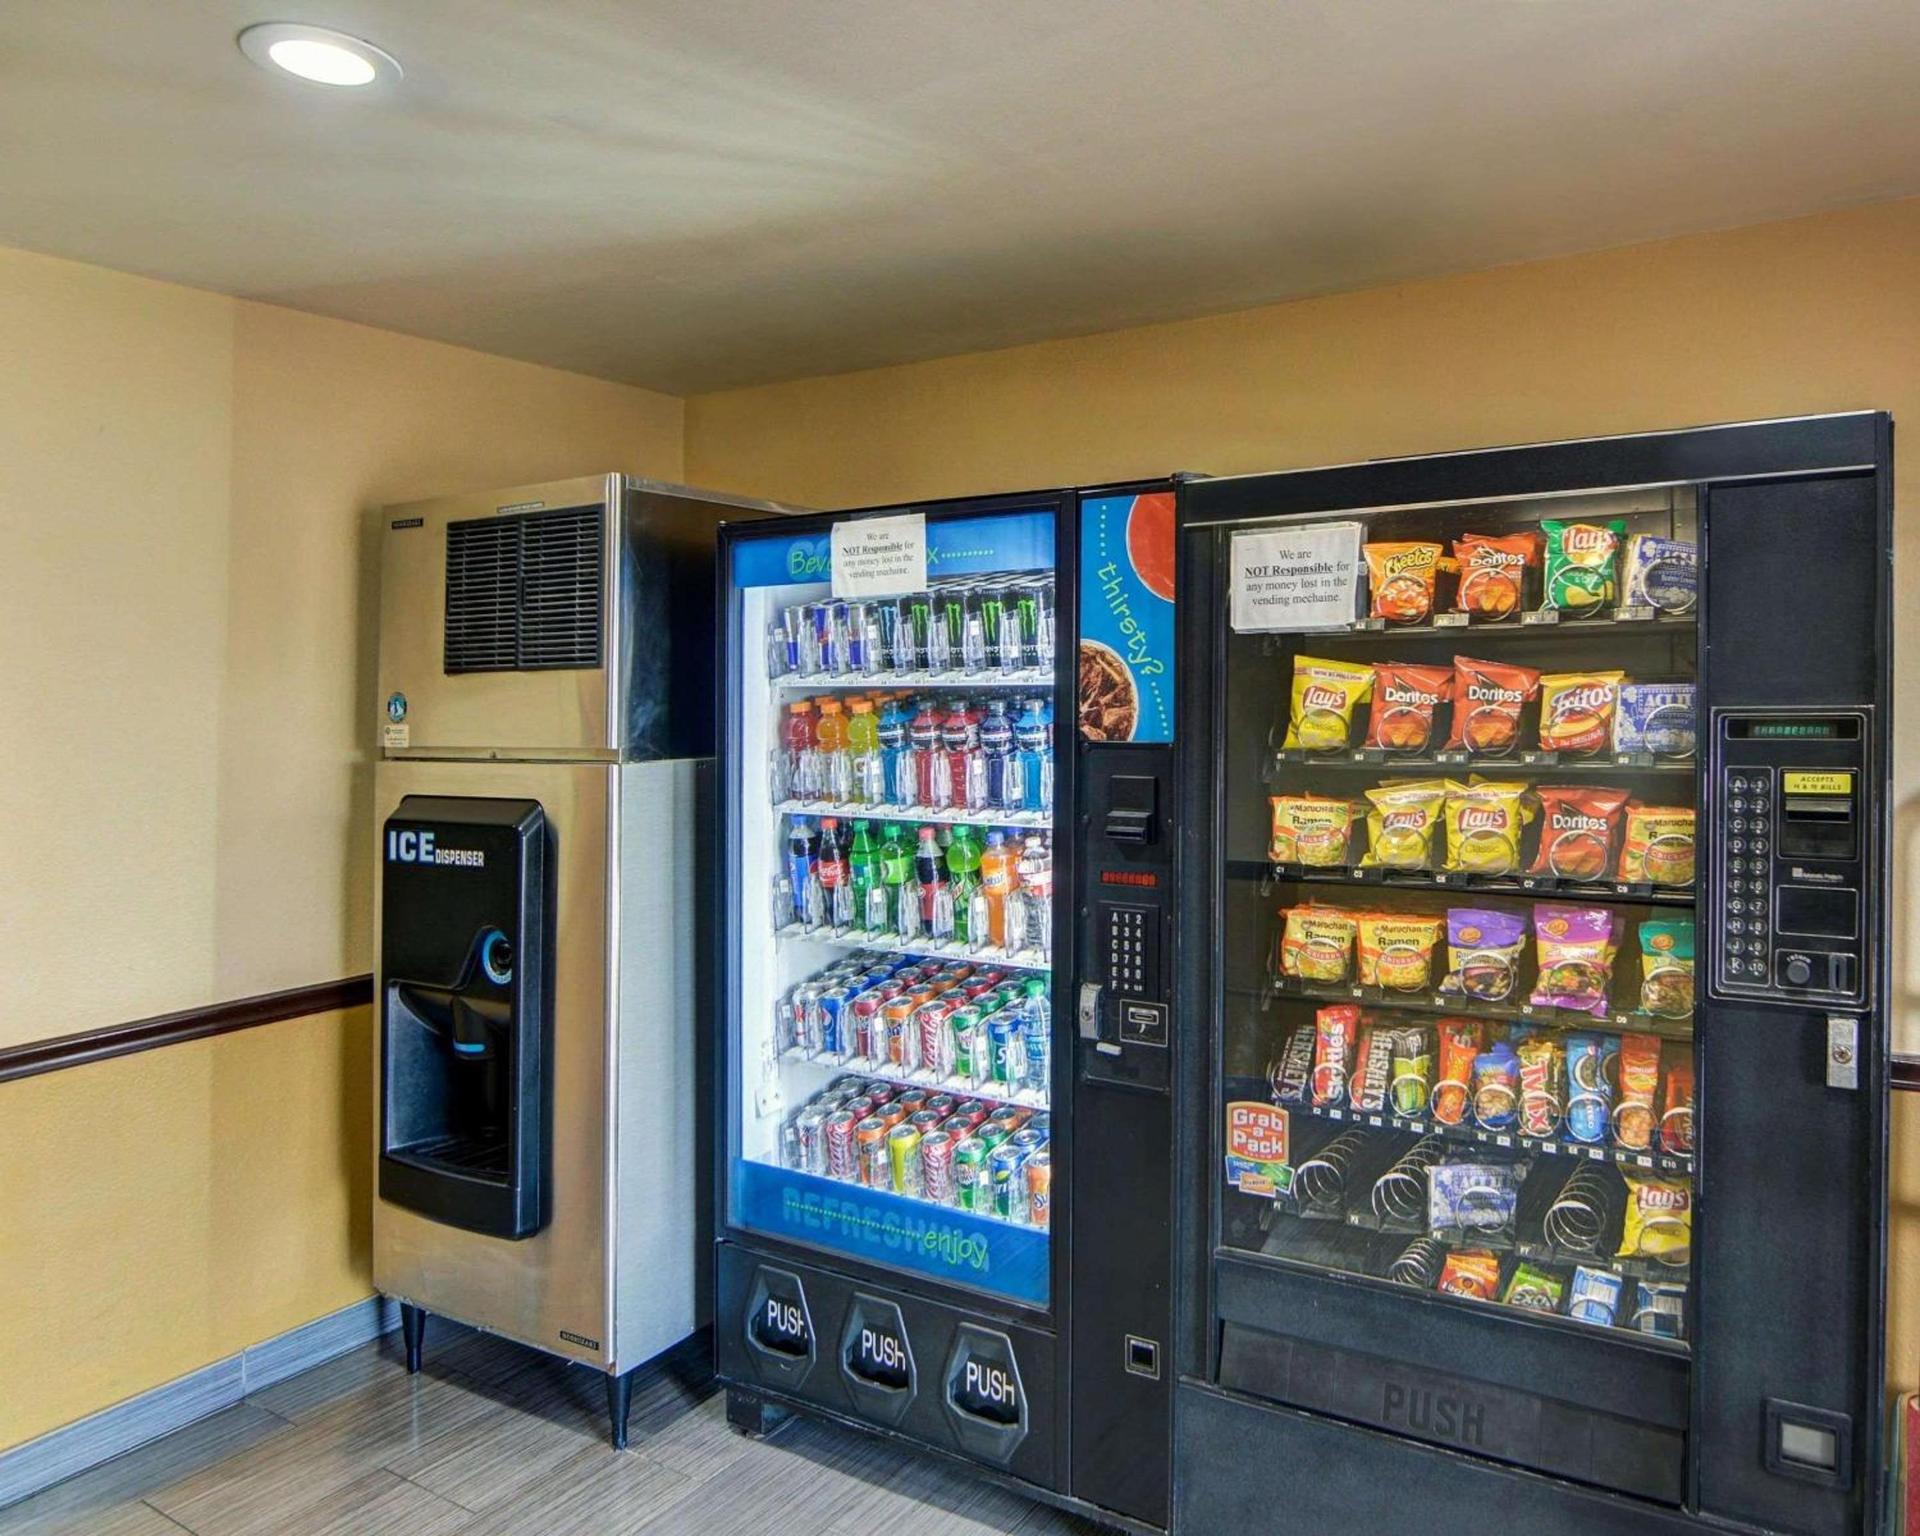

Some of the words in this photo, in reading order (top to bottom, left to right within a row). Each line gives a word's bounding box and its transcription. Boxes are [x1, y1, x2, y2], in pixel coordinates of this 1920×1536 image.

[842, 546, 860, 556] NOT
[862, 542, 902, 554] Responsible
[904, 541, 914, 549] for
[858, 558, 880, 567] money
[904, 554, 914, 562] the
[1280, 550, 1294, 560] We
[1297, 551, 1312, 559] are
[1384, 548, 1434, 574] Cheetos
[1469, 552, 1525, 566] Doritos
[849, 570, 874, 580] vending
[1244, 566, 1272, 578] NOT
[1272, 562, 1334, 577] Responsible
[1335, 561, 1350, 571] for
[1246, 583, 1262, 593] any
[1265, 581, 1298, 592] money
[1300, 578, 1318, 589] lost
[1321, 578, 1331, 587] in
[1333, 576, 1348, 586] the
[1252, 595, 1290, 607] vending
[1097, 562, 1164, 675] thirsty?
[1305, 687, 1346, 709] Lay's
[1385, 687, 1438, 704] Doritos
[1468, 686, 1523, 702] Doritos
[1550, 684, 1614, 711] Fritos
[1644, 694, 1676, 707] ACT
[1735, 780, 1741, 788] A
[1734, 800, 1742, 808] B
[1756, 801, 1763, 809] 2
[1461, 808, 1506, 830] Lay's
[1552, 814, 1608, 830] Doritos
[1734, 820, 1742, 829] C
[1756, 821, 1762, 829] 3
[389, 830, 434, 862] ICE
[436, 849, 484, 867] DISPENSER
[1734, 840, 1742, 848] D
[1756, 841, 1762, 849] 4
[1276, 866, 1284, 874] C1
[1756, 861, 1762, 869] 5
[1353, 870, 1363, 878] C3
[1524, 880, 1534, 888] C7
[1756, 881, 1762, 890] 6
[1732, 900, 1740, 909] G
[1756, 902, 1762, 910] 7
[1112, 912, 1118, 922] A
[1125, 914, 1129, 923] 1
[1136, 914, 1142, 924] 2
[1309, 920, 1348, 930] Maruchan
[1381, 924, 1422, 933] Maruchan
[1732, 920, 1740, 929] H
[1124, 927, 1130, 937] 3
[1136, 928, 1141, 938] 4
[1305, 931, 1344, 943] Ramen
[1112, 940, 1118, 950] C
[1378, 938, 1420, 946] Ramen
[1732, 940, 1740, 949] J
[1112, 953, 1118, 962] D
[1124, 954, 1129, 964] 7
[1732, 958, 1740, 970] K
[1112, 966, 1117, 976] E
[1124, 968, 1129, 978] 9
[1112, 980, 1118, 990] F
[1280, 1025, 1316, 1099] HERSHEY'S
[1362, 1030, 1392, 1110] HERSHEY'S
[1520, 1060, 1549, 1130] TWIX
[1233, 1108, 1282, 1132] Grab
[1253, 1127, 1264, 1138] a
[1233, 1128, 1282, 1154] Pack
[1662, 1160, 1677, 1168] E10
[1639, 1186, 1686, 1212] Lay's
[924, 1230, 987, 1268] enjoy
[862, 1330, 906, 1371] PUSH
[966, 1361, 1014, 1406] PUSH
[1382, 1382, 1484, 1444] PUSH
